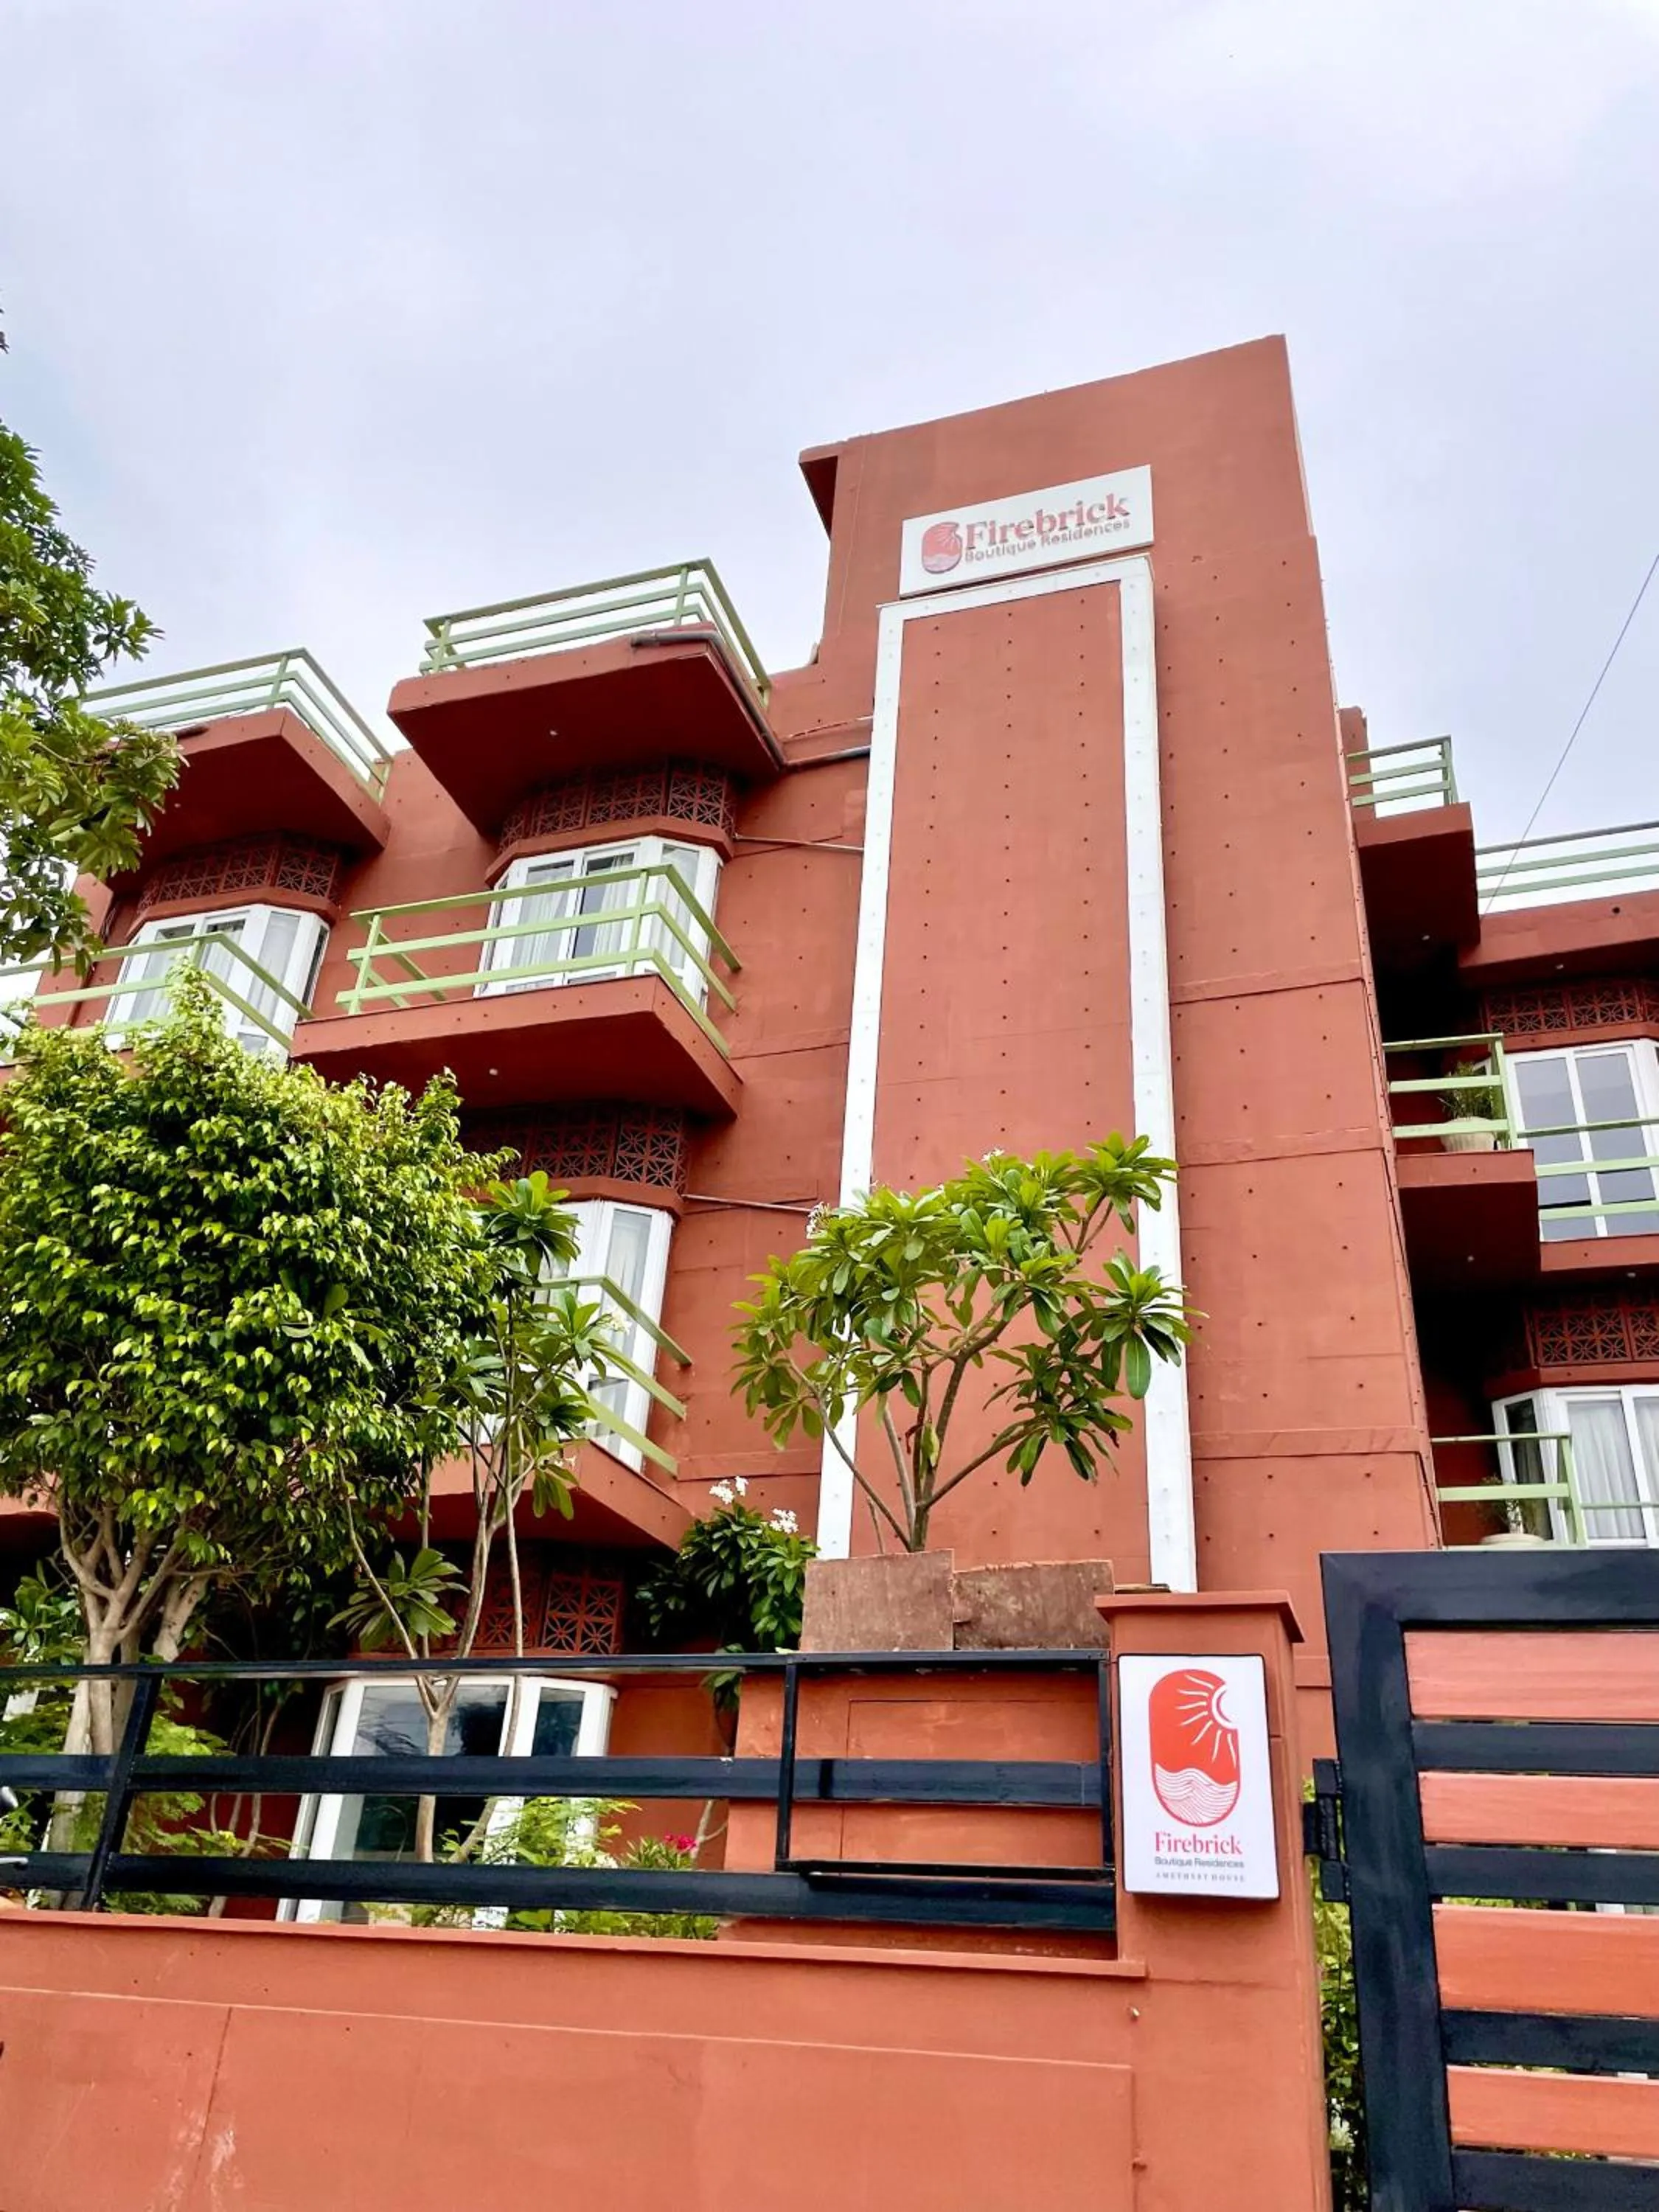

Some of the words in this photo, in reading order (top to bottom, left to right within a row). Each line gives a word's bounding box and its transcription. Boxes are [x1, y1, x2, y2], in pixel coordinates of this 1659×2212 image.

[965, 493, 1130, 549] Firebrick
[964, 540, 1036, 563] Boutique
[1040, 518, 1130, 546] Residences
[1155, 1832, 1243, 1855] Firebrick
[1155, 1857, 1192, 1867] Boutique
[1194, 1857, 1245, 1868] Residences
